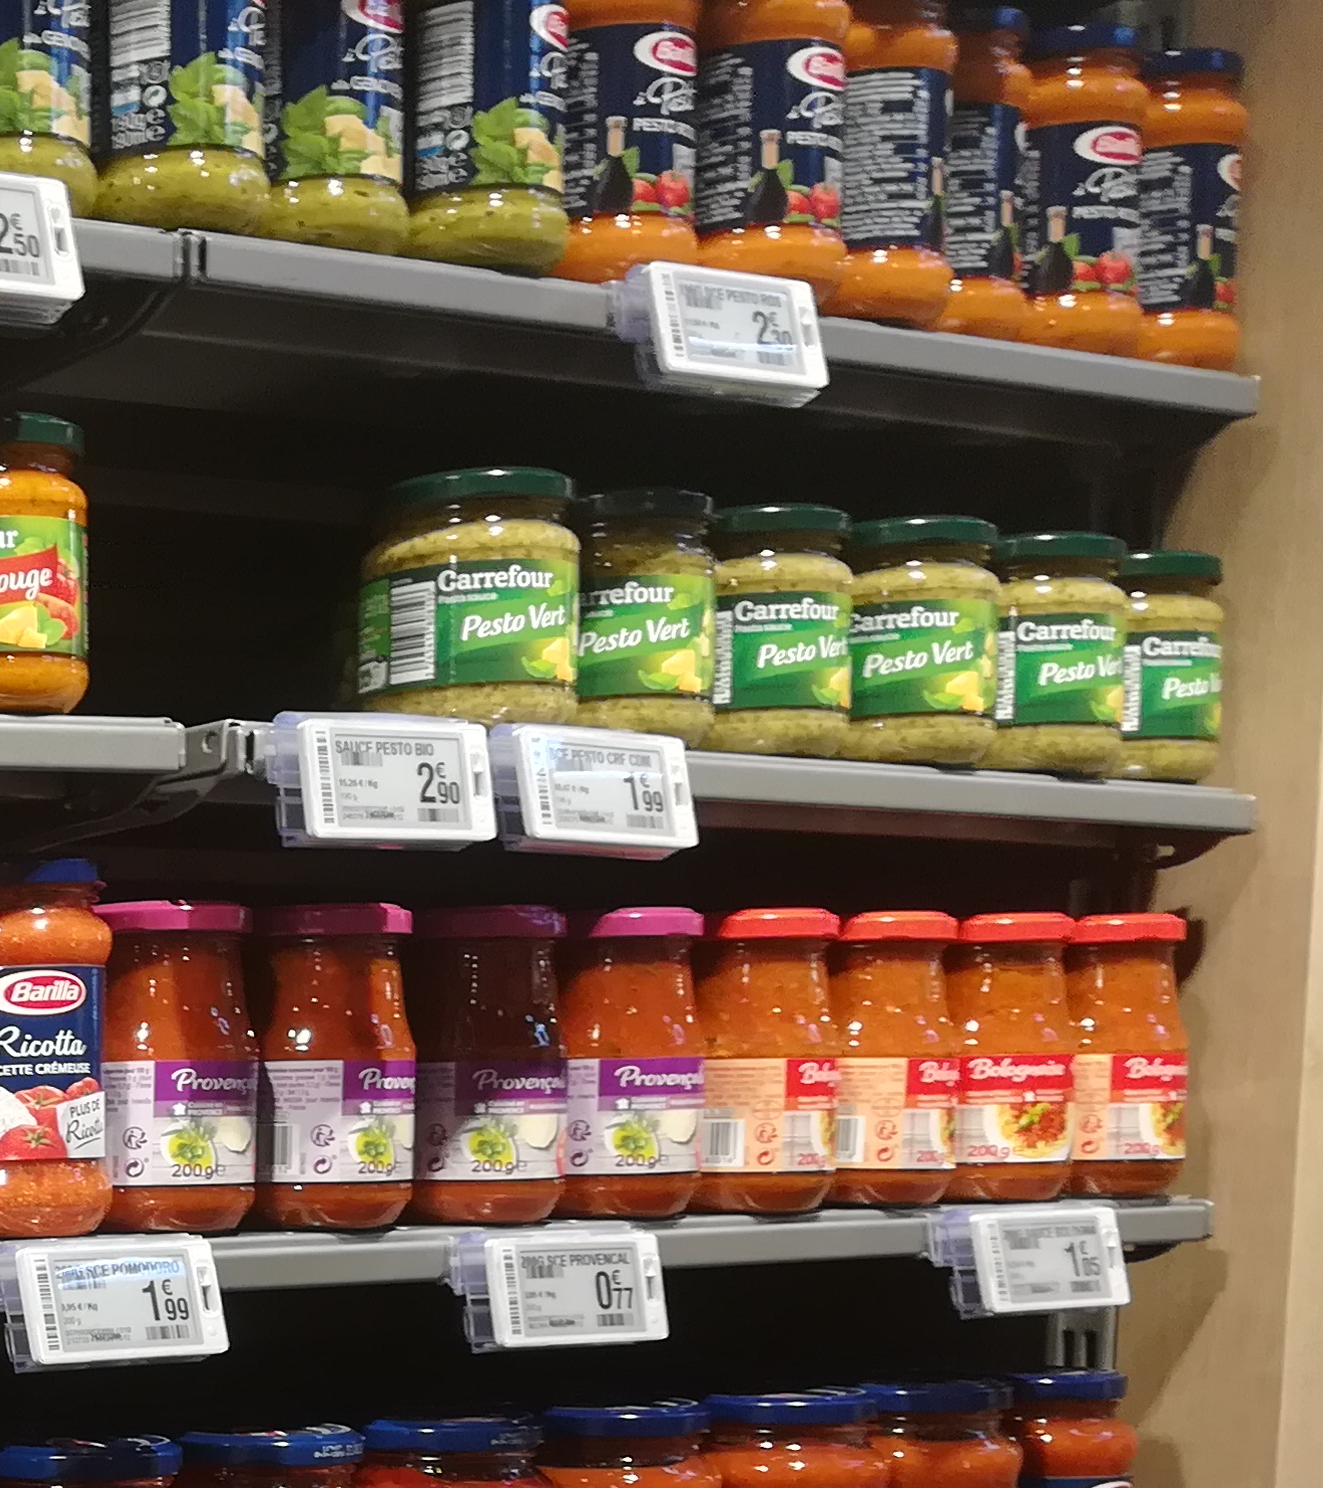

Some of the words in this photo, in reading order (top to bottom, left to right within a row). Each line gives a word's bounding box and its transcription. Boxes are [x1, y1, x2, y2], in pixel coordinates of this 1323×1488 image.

[437, 564, 554, 591] Carrefour
[461, 610, 523, 641] Pesto
[528, 603, 567, 633] Vert
[734, 599, 838, 625] Carrefour
[579, 625, 641, 655] Pesto
[646, 617, 691, 647] Vert
[1017, 620, 1116, 646] Carrefour
[863, 647, 927, 677] Pesto
[931, 639, 975, 667] Vert
[377, 740, 410, 756] PESTO
[414, 742, 434, 757] BIO
[9, 980, 79, 1005] Barilla
[35, 1059, 90, 1075] CRÉMEUSE
[70, 1104, 88, 1118] PLUS
[90, 1100, 101, 1112] DE
[111, 1260, 180, 1276] POMODORO
[568, 1254, 629, 1268] PROVENCAL
